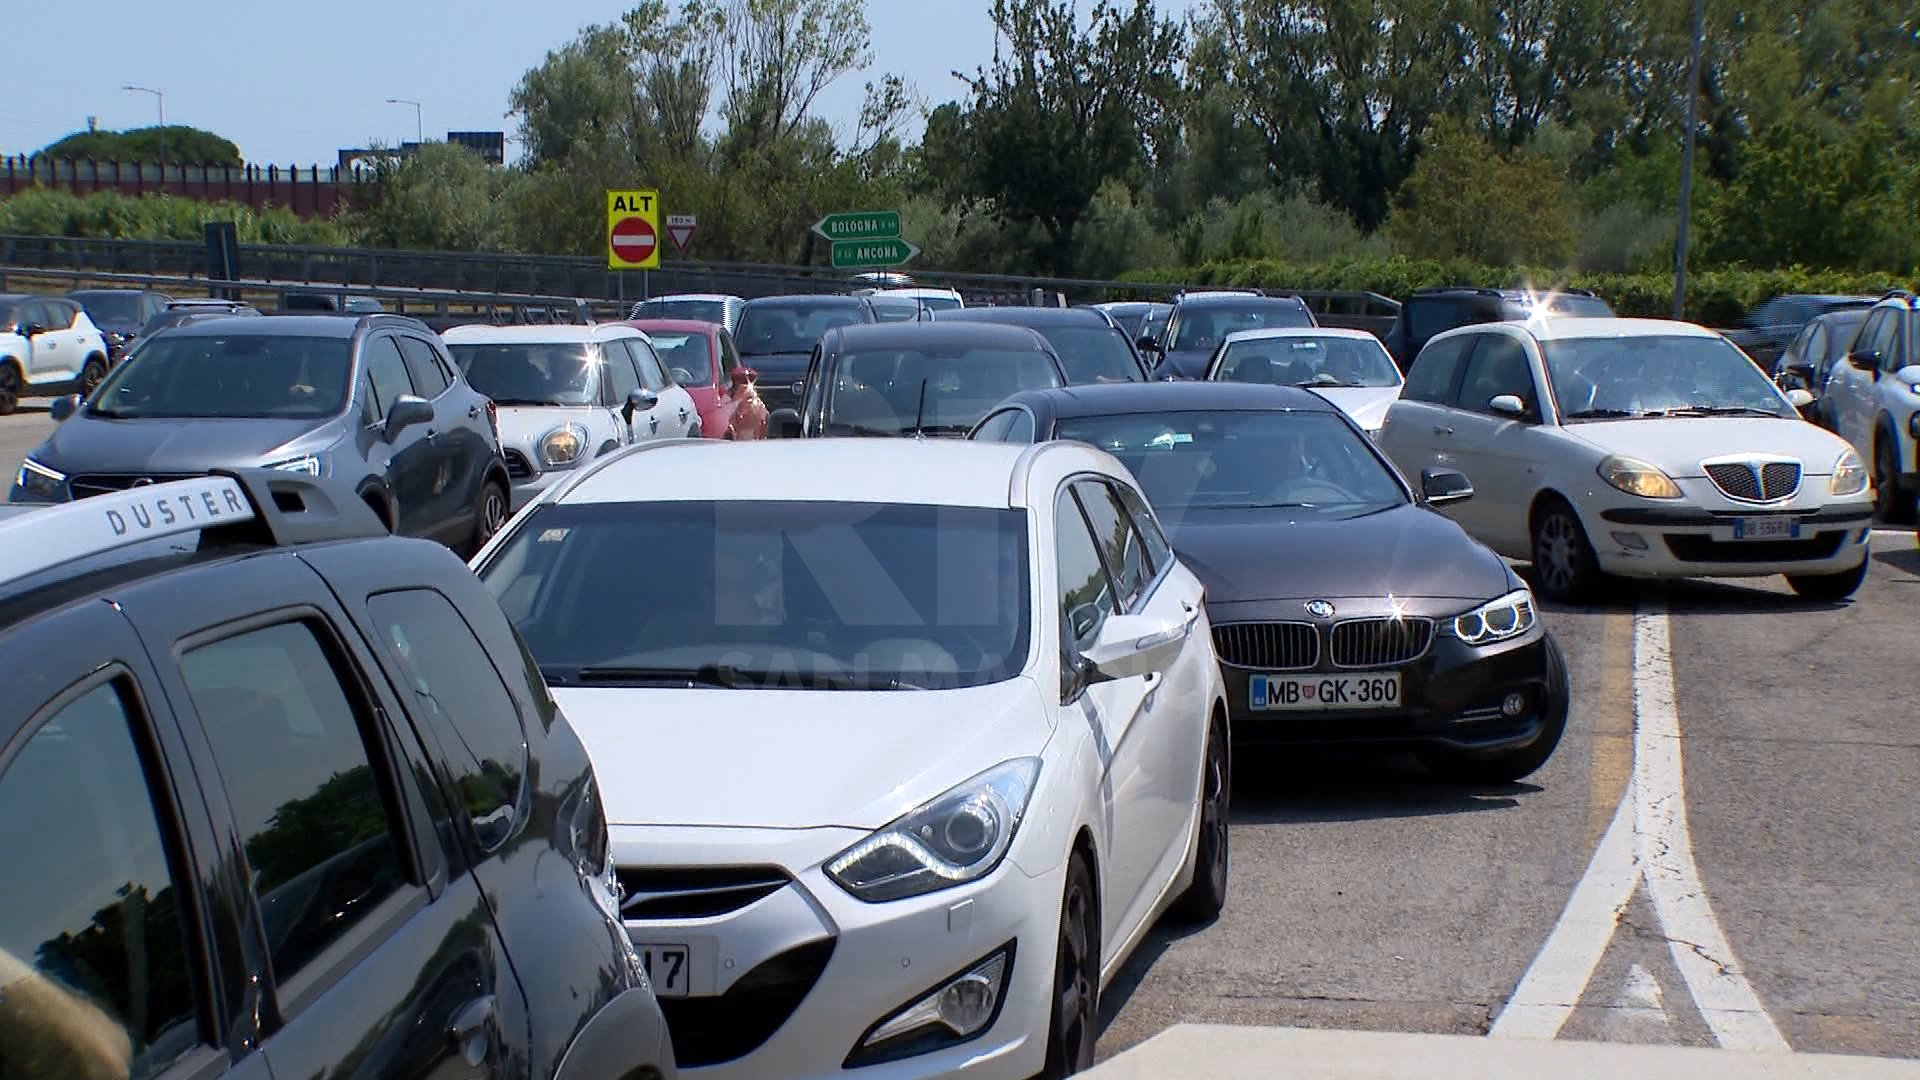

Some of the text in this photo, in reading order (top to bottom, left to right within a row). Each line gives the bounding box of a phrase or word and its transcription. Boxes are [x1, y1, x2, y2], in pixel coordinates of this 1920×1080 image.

[613, 196, 653, 212] ALT
[831, 219, 878, 233] BOLOGNA
[857, 246, 898, 260] ANCONA
[105, 488, 243, 536] DUSTER
[1268, 678, 1397, 705] MB GK-360
